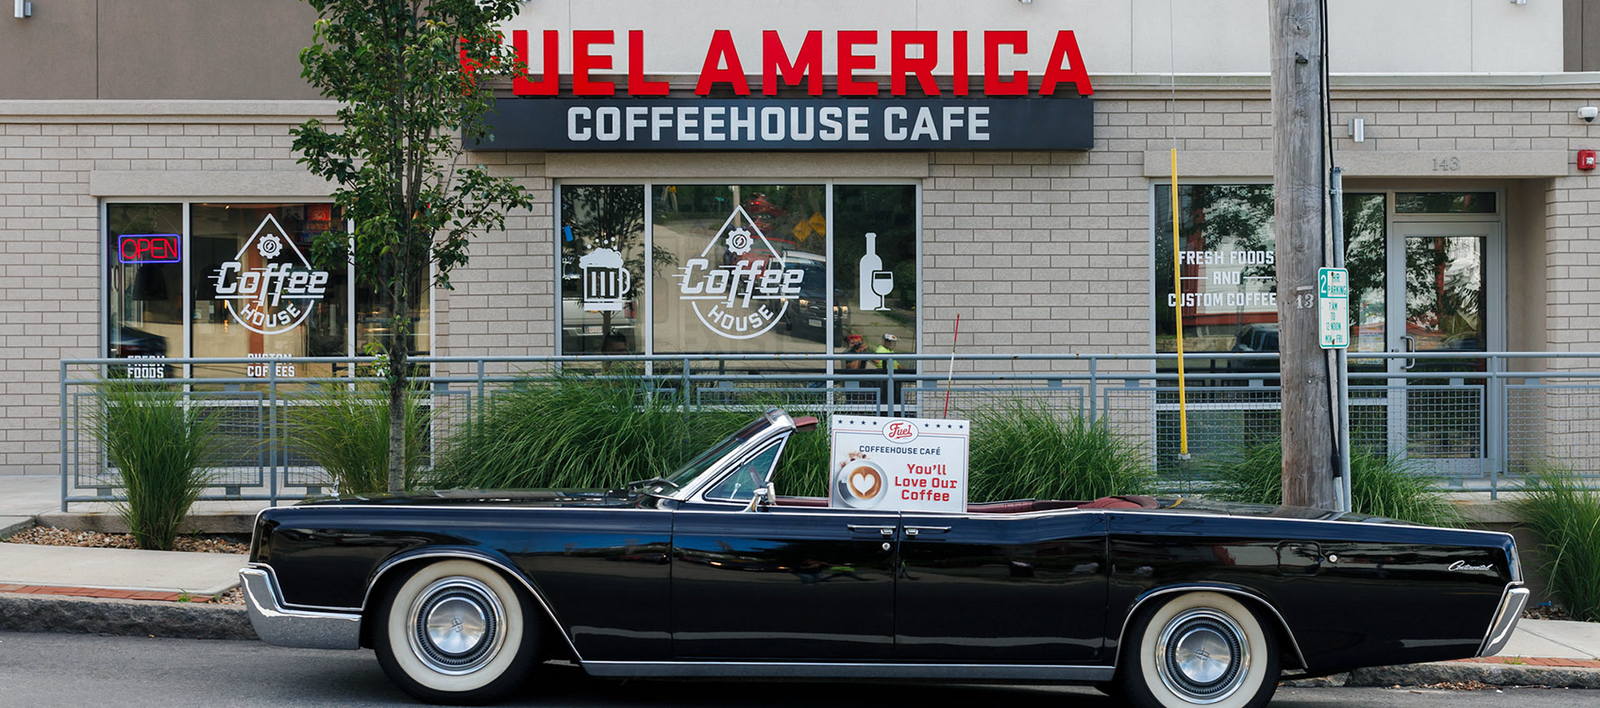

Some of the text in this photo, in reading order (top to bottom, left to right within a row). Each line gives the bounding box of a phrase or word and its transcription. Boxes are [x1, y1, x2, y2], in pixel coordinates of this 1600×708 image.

[694, 30, 1094, 95] AMERICA
[567, 106, 990, 142] COFFEEHOUSE CAFE
[1431, 156, 1461, 172] 143
[121, 238, 178, 260] OPEN
[1178, 250, 1274, 265] FRESH FOODS
[208, 261, 329, 307] Coffee
[672, 258, 805, 308] Coffee
[1213, 271, 1241, 285] AND
[1320, 274, 1327, 294] 2
[1327, 285, 1347, 296] PARKING
[1296, 293, 1315, 310] 13
[240, 303, 301, 328] HOUSE
[707, 304, 774, 332] HOUSE
[127, 366, 165, 379] FOODS
[247, 365, 295, 378] COFEES
[888, 422, 913, 439] Fuel
[859, 445, 941, 456] COFFEEHOUSE CAFÉ
[907, 463, 947, 476] You'll
[894, 476, 958, 489] Love Our
[901, 489, 950, 502] Coffee
